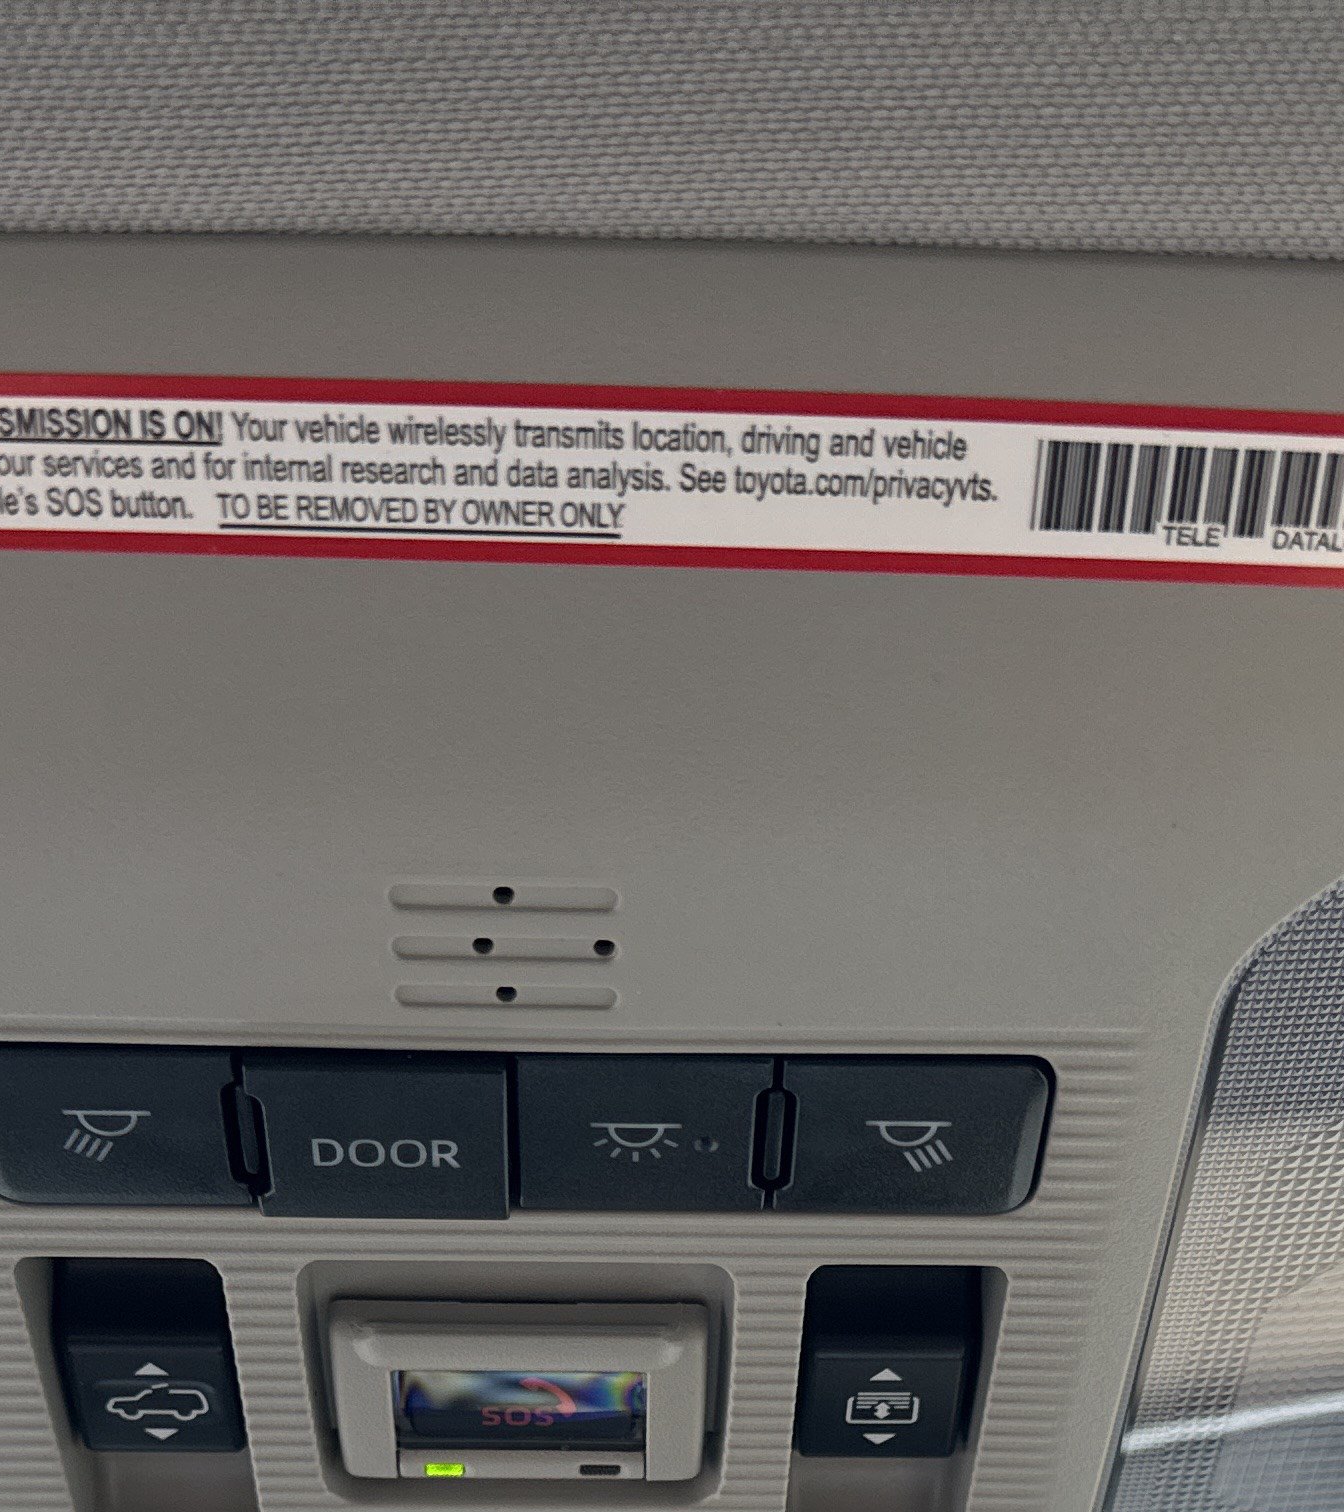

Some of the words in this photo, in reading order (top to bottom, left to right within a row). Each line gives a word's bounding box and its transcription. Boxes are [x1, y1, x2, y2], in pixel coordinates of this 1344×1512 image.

[140, 408, 167, 440] IS
[174, 408, 224, 442] ON!
[231, 411, 288, 443] Your
[294, 413, 380, 444] vehicle
[388, 415, 506, 455] wirelessly
[514, 419, 624, 451] transmits
[633, 420, 732, 458] location,
[741, 424, 820, 464] driving
[829, 427, 875, 458] and
[883, 429, 967, 461] vehicle
[43, 450, 144, 479] services
[151, 451, 196, 480] and
[203, 451, 236, 481] for
[243, 452, 332, 483] internal
[341, 457, 446, 486] research
[454, 458, 498, 487] and
[507, 458, 558, 489] data
[567, 461, 670, 498] analysis.
[679, 463, 726, 494] See
[46, 486, 103, 517] SOS
[110, 489, 193, 520] button.
[215, 492, 250, 520] TO
[257, 494, 289, 521] BE
[296, 495, 418, 524] REMOVED
[424, 498, 457, 524] BY
[462, 498, 555, 528] OWNER
[560, 501, 626, 529] ONLY
[1162, 525, 1221, 548] TELE
[311, 1137, 462, 1169] DOOR
[480, 1405, 555, 1427] SOS
